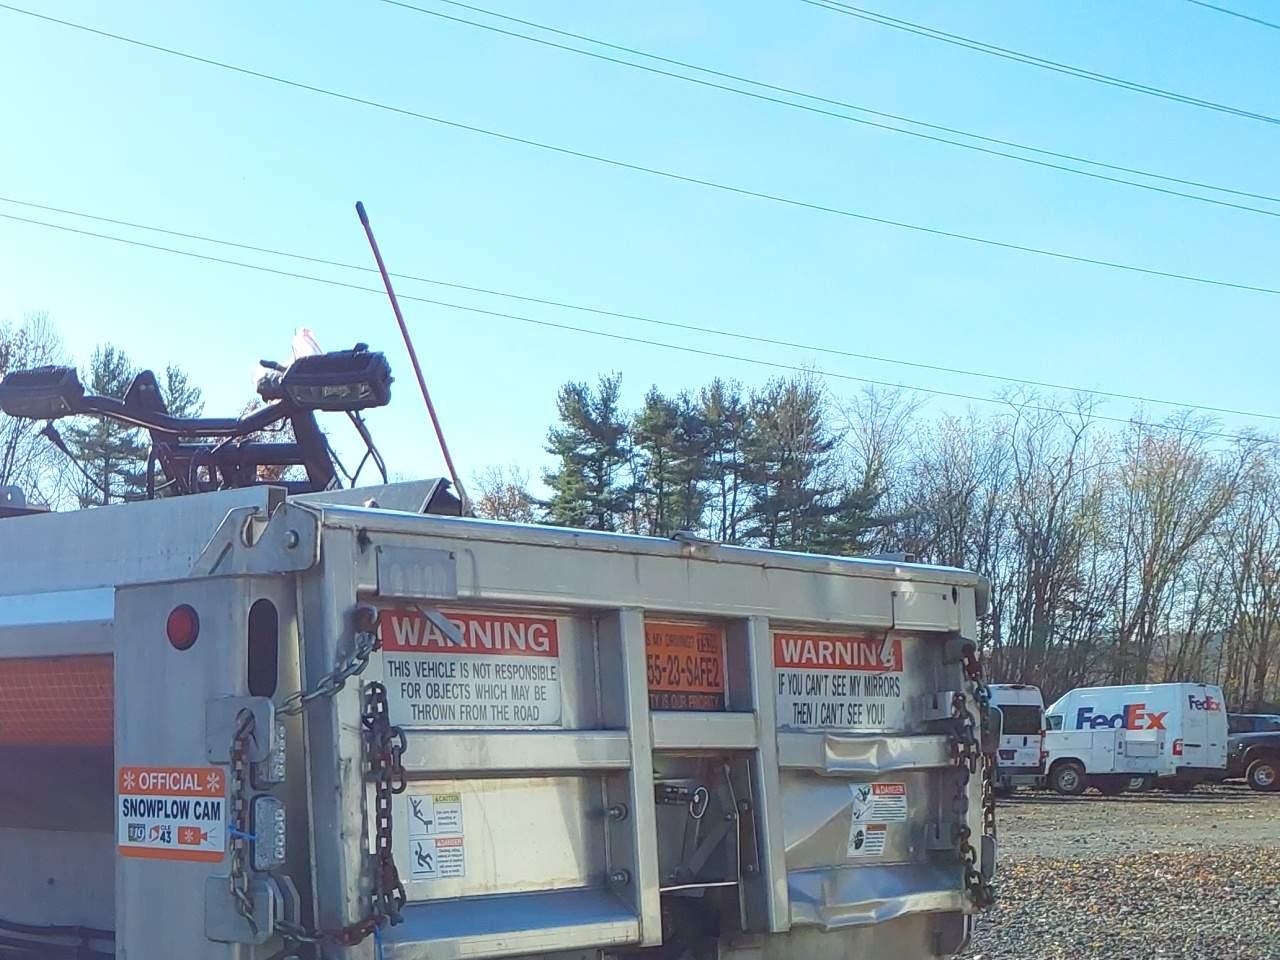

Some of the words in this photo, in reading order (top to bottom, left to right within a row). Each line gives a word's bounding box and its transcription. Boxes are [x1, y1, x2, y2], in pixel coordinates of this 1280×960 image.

[391, 616, 550, 652] WARNING
[388, 660, 410, 677] THIS
[415, 661, 456, 678] VEHICLE
[460, 662, 469, 678] IS
[472, 663, 491, 679] NOT
[495, 664, 557, 681] RESPONSIBLE
[401, 683, 422, 698] FOR
[425, 683, 470, 699] OBJECTS
[474, 684, 507, 700] WHICH
[511, 685, 530, 701] MAY
[534, 685, 547, 701] BE
[778, 673, 785, 695] IF
[787, 673, 802, 696] YOU
[805, 674, 829, 696] CAN'T
[832, 675, 846, 696] SEE
[849, 675, 861, 696] MY
[864, 676, 900, 697] MIRRORS
[411, 704, 456, 720] THROWN
[460, 704, 487, 721] FROM
[490, 705, 509, 721] THE
[513, 705, 540, 721] ROAD
[792, 702, 813, 725] THEN
[820, 703, 844, 725] CAN'T
[847, 703, 863, 724] SEE
[866, 704, 886, 724] YOU!
[1188, 695, 1221, 712] FedEx
[1076, 703, 1169, 730] FedEx
[139, 772, 203, 790] OFFICIAL
[123, 799, 190, 819] SNOWPLOW
[194, 801, 220, 821] CAM
[160, 831, 171, 844] 43
